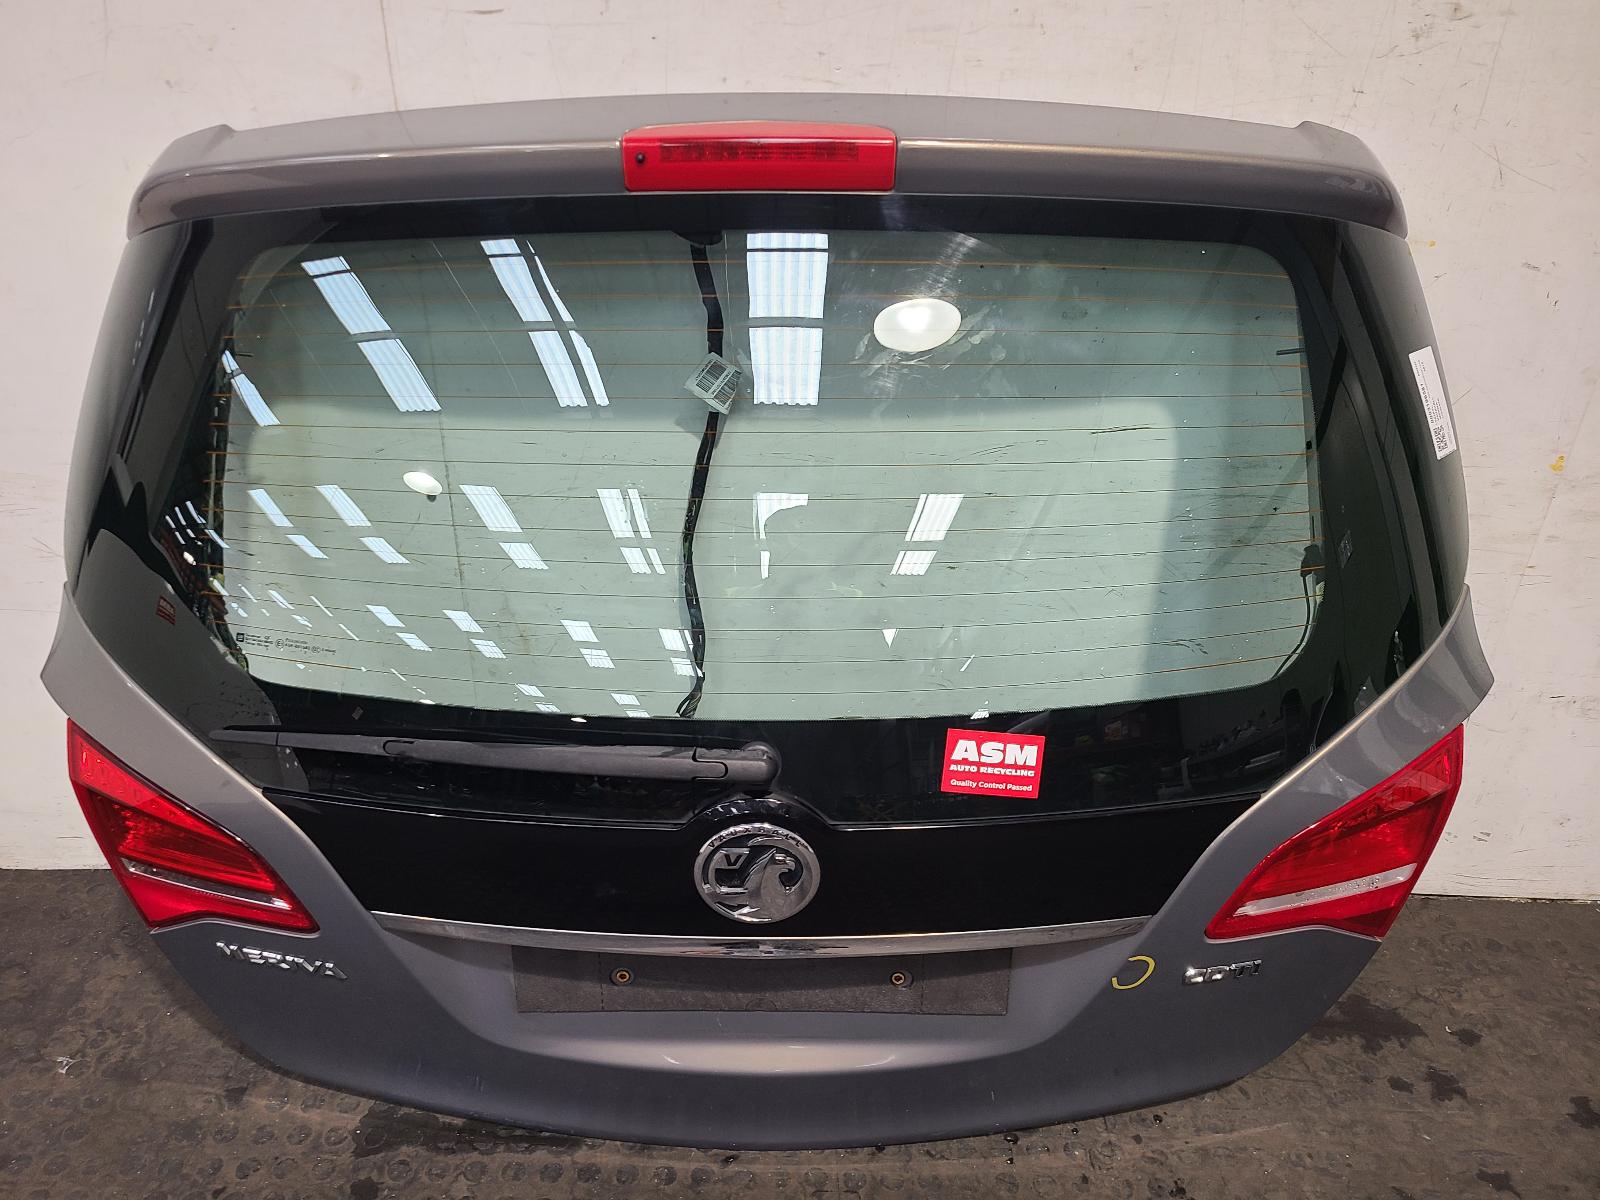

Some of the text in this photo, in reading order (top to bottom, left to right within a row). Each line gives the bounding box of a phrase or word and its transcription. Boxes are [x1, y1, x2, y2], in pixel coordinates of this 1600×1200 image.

[951, 739, 1038, 767] ASM
[949, 764, 1035, 777] AUTO RECYCLING
[950, 779, 1033, 792] Quality Control Passed
[1182, 959, 1262, 985] CDTI
